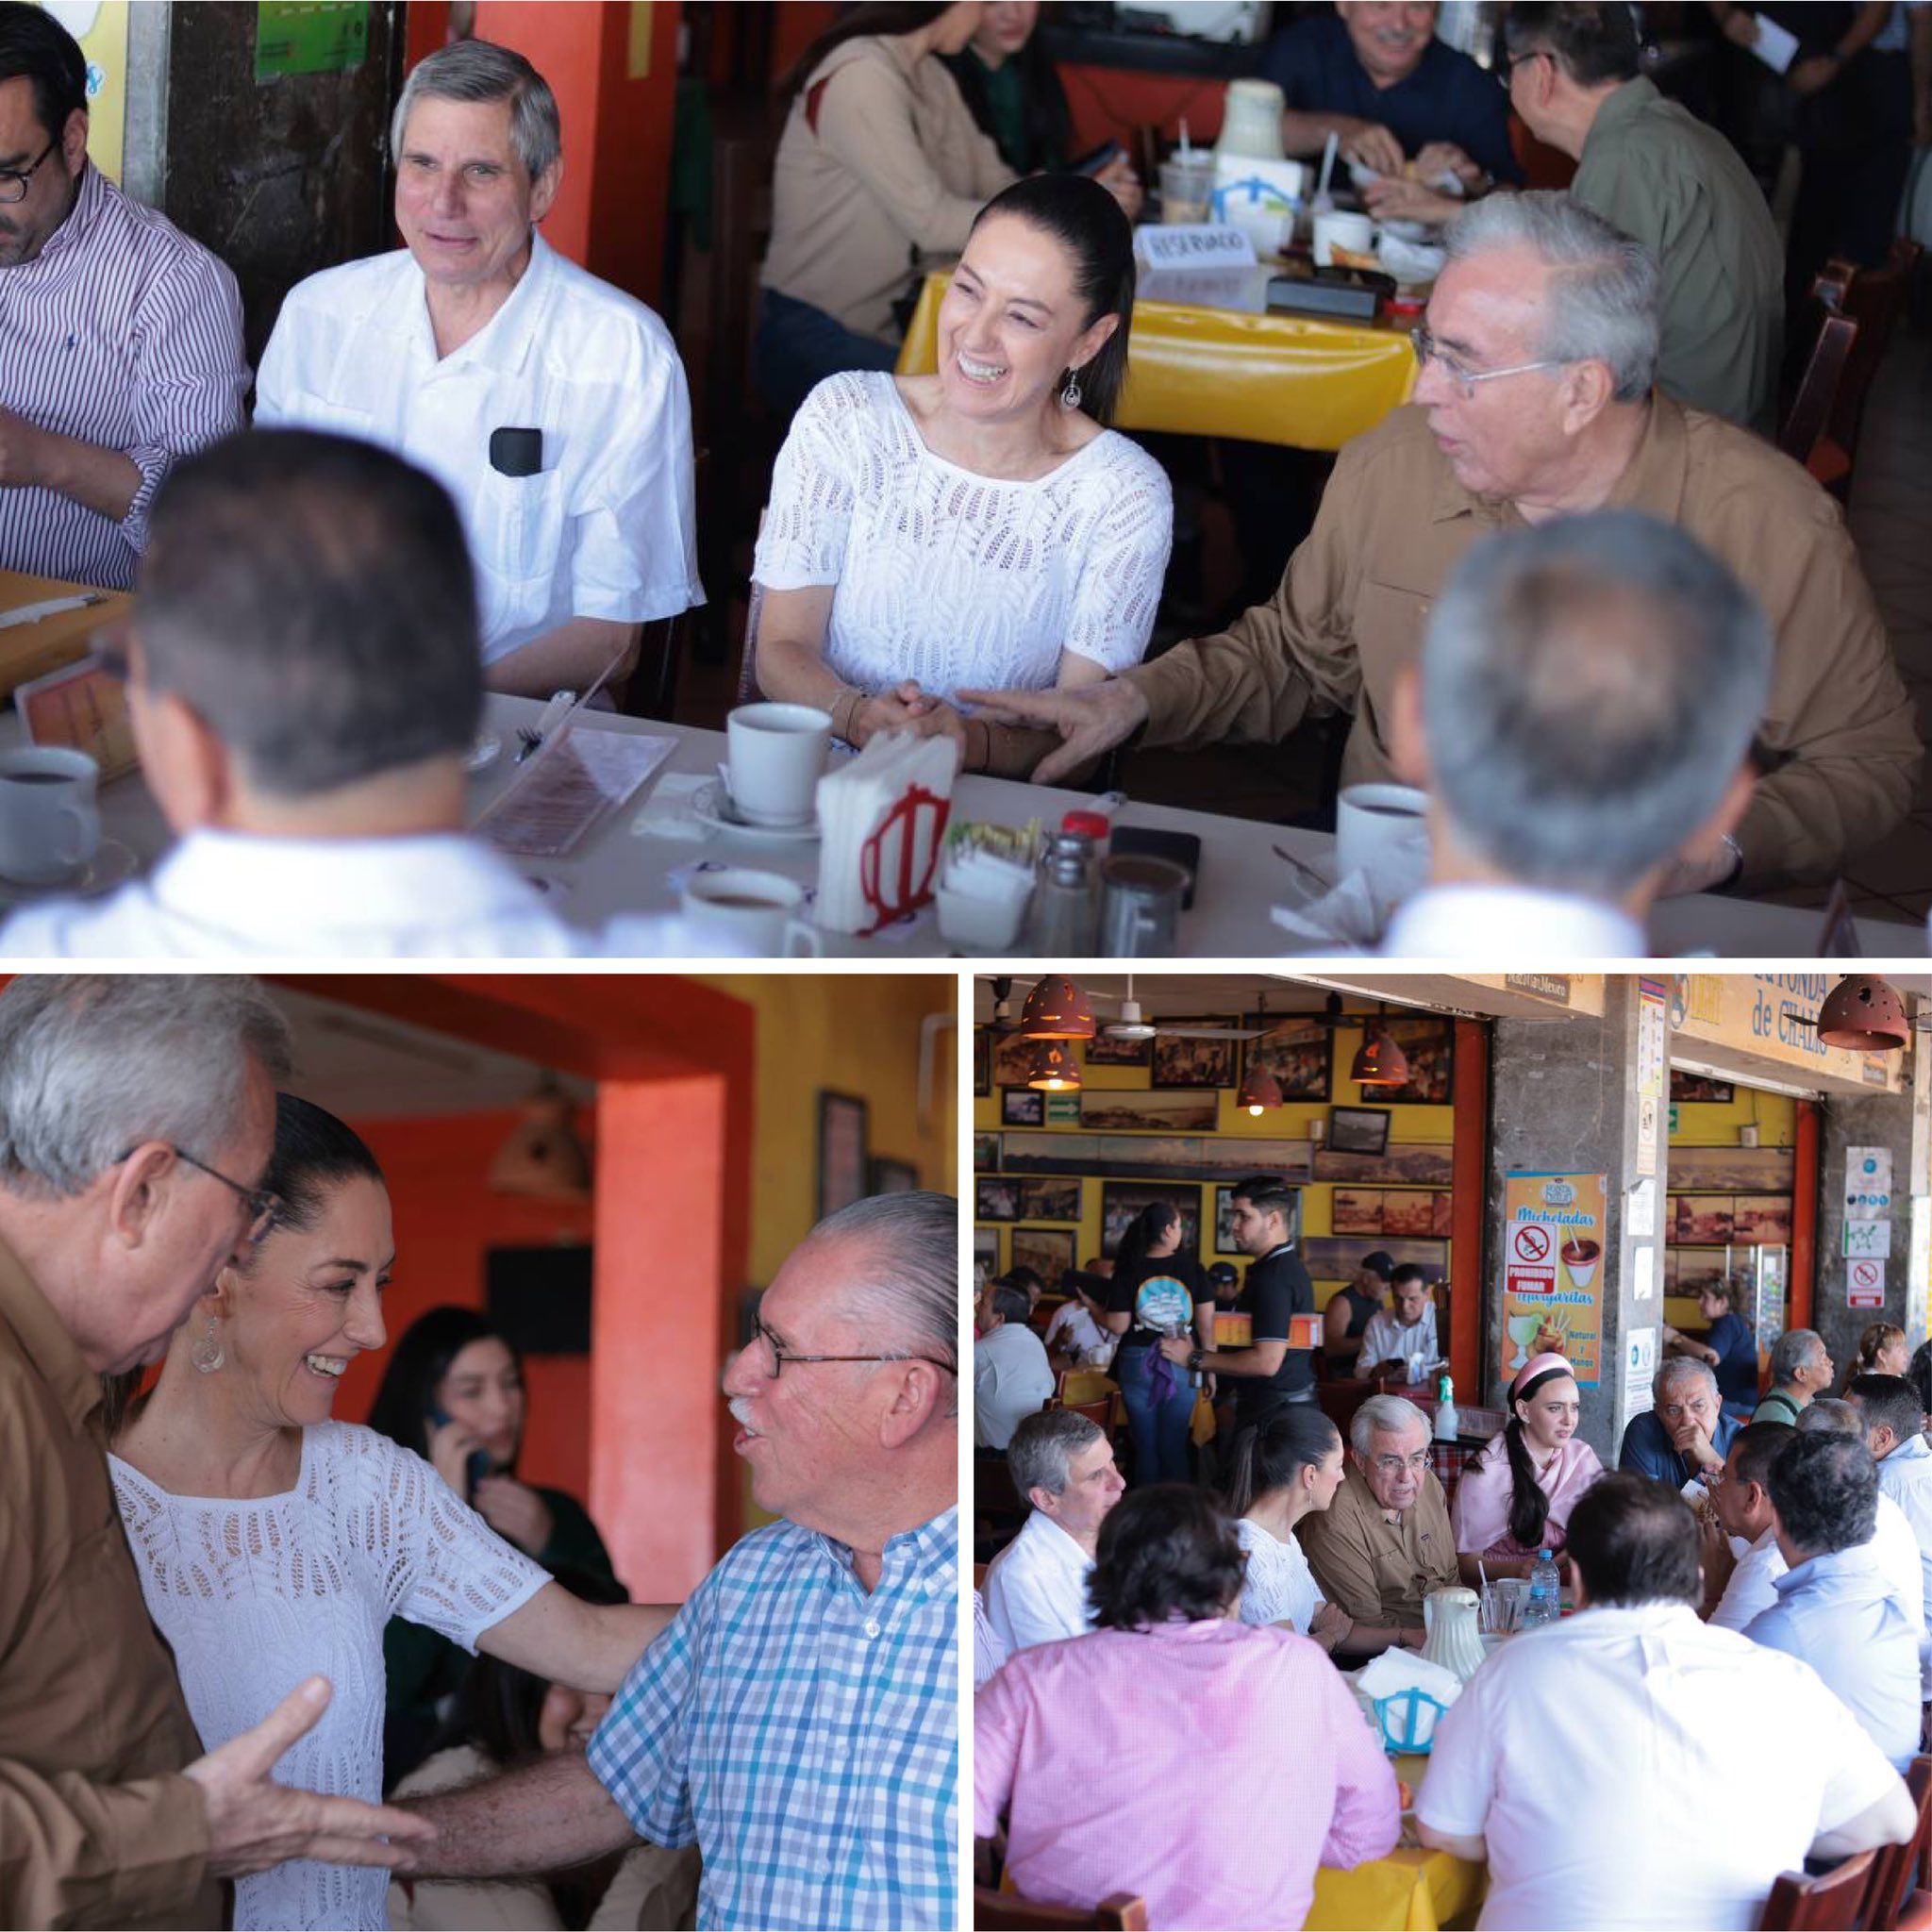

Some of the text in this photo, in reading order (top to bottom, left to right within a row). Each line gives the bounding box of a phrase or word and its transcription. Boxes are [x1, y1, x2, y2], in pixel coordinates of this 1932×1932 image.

[1752, 989, 1773, 1037] de
[1518, 1207, 1594, 1226] Micheladas
[1509, 1266, 1554, 1279] PROHIBIDO
[1517, 1279, 1545, 1292] FUMAR
